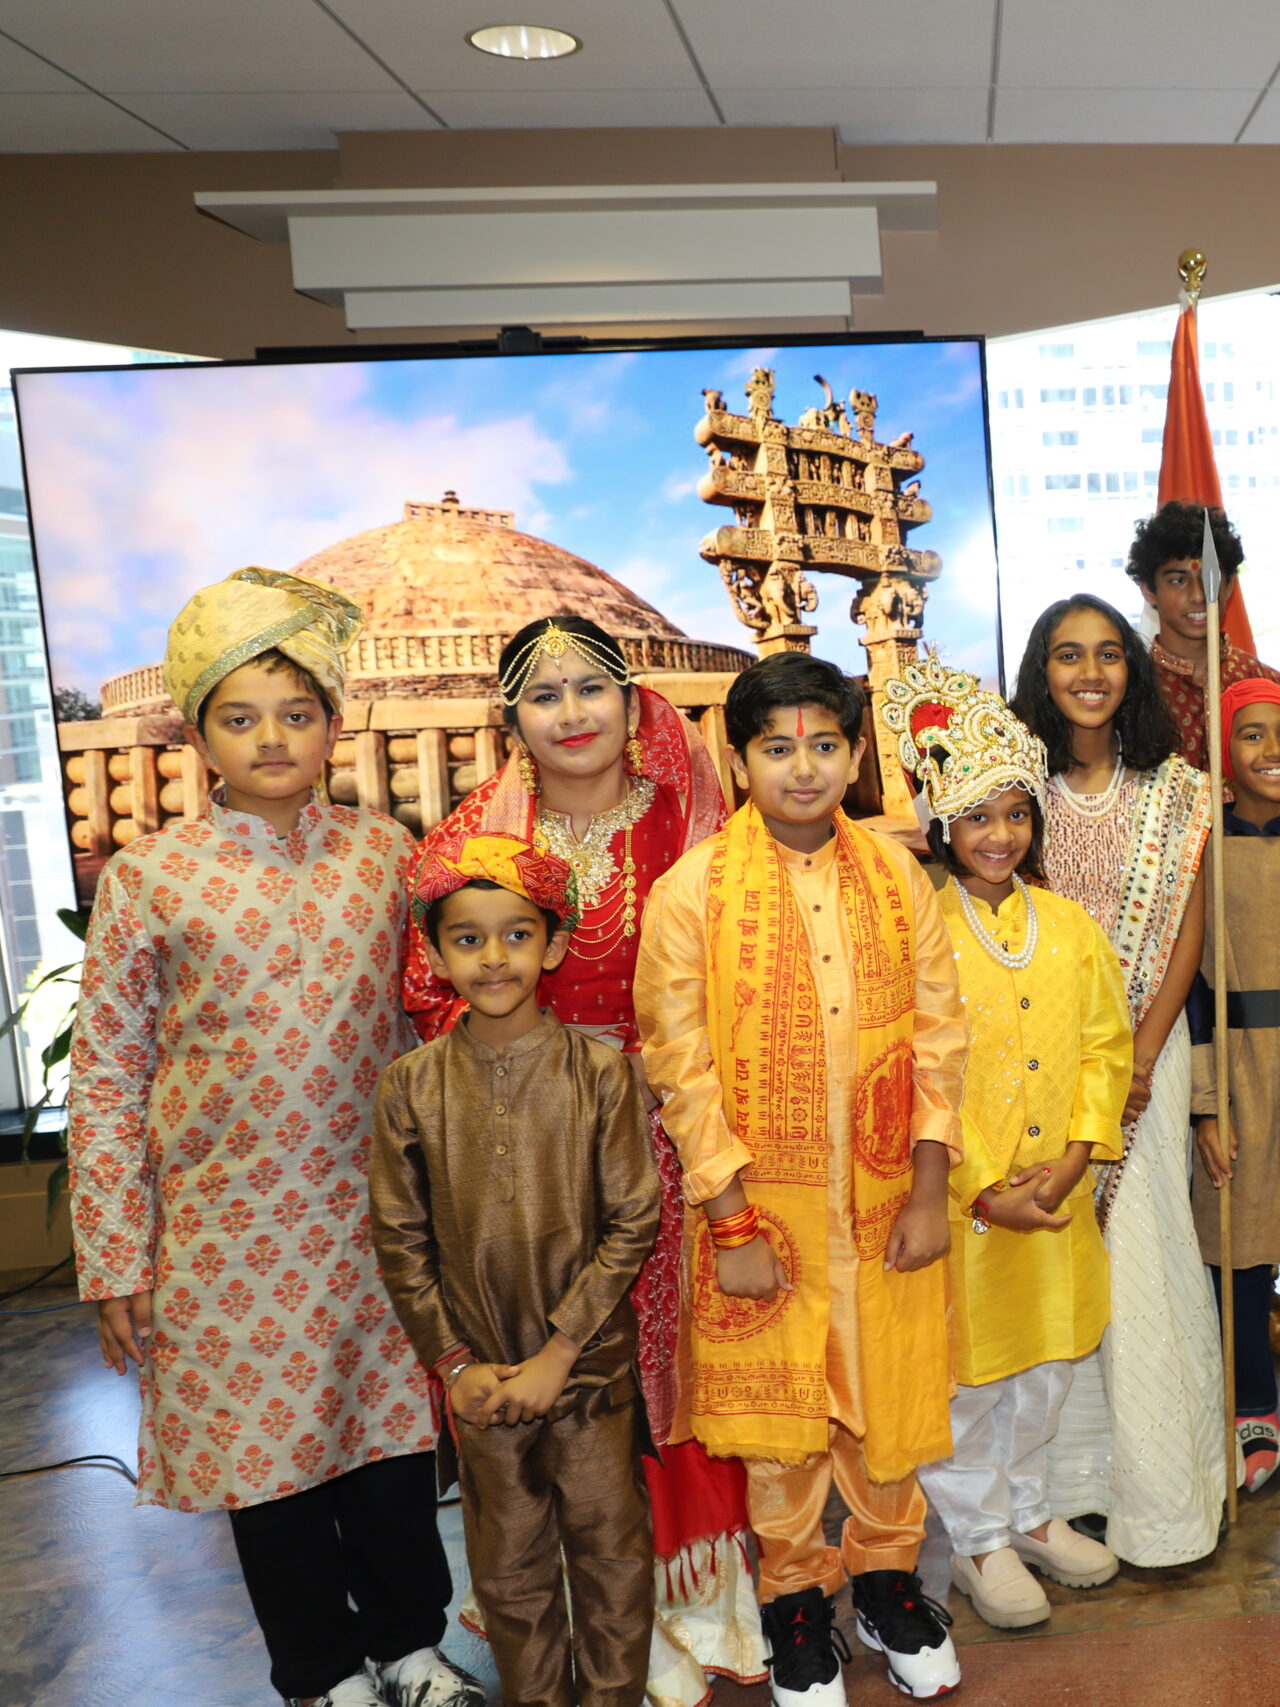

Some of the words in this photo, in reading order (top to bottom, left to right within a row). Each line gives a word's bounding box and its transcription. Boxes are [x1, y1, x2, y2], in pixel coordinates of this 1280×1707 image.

[744, 890, 761, 913] राम
[886, 884, 903, 911] जय
[737, 918, 759, 937] श्री
[894, 915, 911, 934] श्री
[739, 941, 757, 970] जय
[900, 937, 910, 964] राम
[736, 1057, 750, 1082] राम
[732, 1086, 749, 1105] श्री
[736, 1108, 750, 1137] जय
